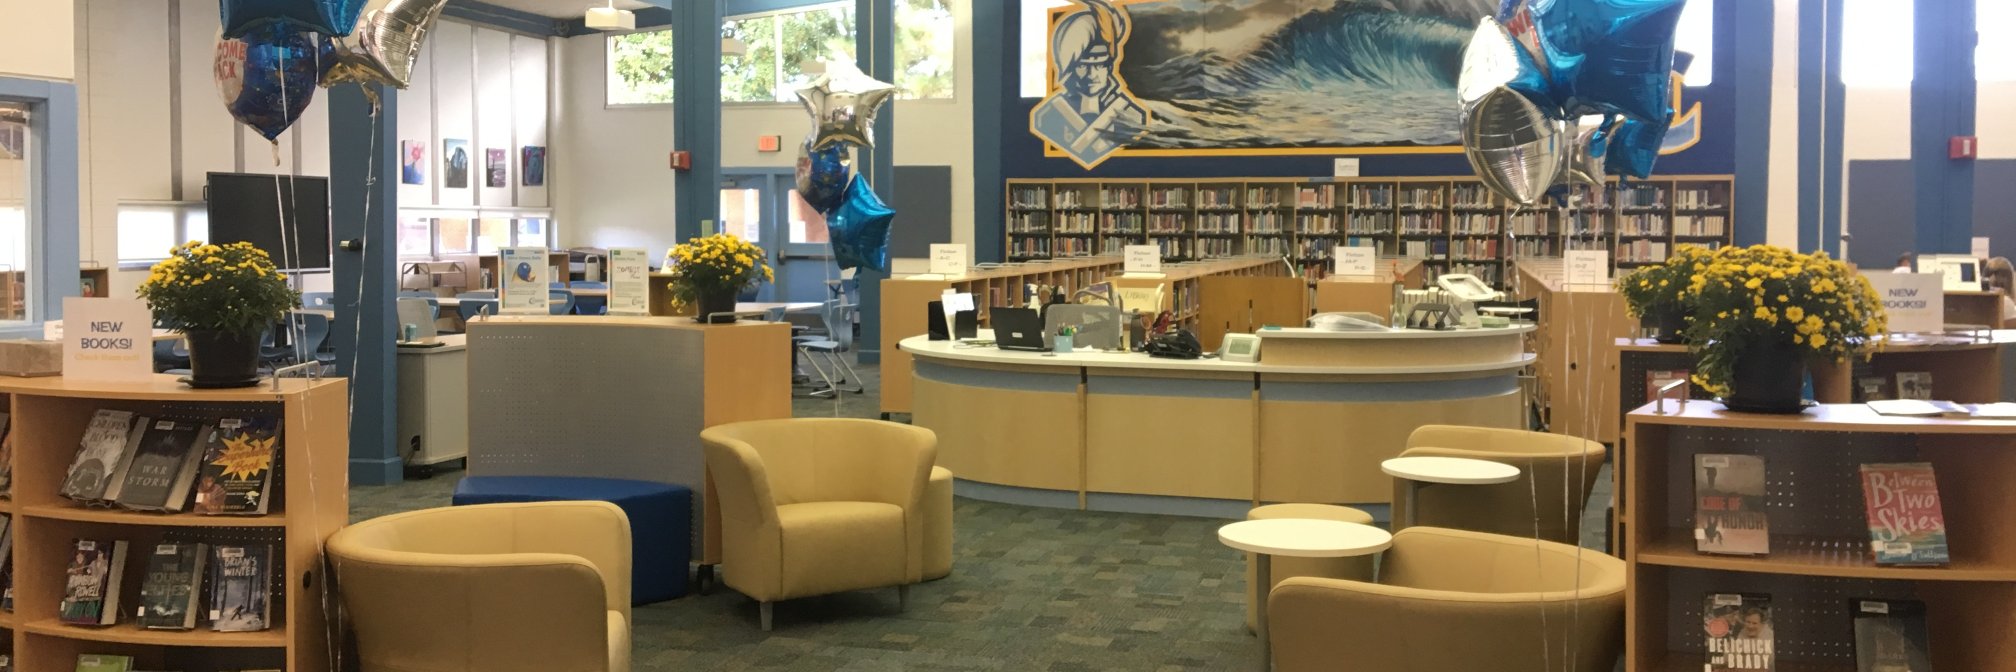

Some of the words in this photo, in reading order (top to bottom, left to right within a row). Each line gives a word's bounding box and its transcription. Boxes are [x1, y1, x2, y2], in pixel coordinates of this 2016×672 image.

[1888, 288, 1919, 298] NEW
[90, 321, 123, 333] NEW
[80, 337, 133, 350] BOOKS!
[142, 465, 168, 475] WAR
[128, 476, 171, 488] STORM
[1893, 488, 1936, 514] Two
[1877, 506, 1942, 542] Skies
[224, 566, 258, 577] WINTER
[1709, 637, 1773, 654] BELICHICK
[1727, 653, 1770, 669] BRADY
